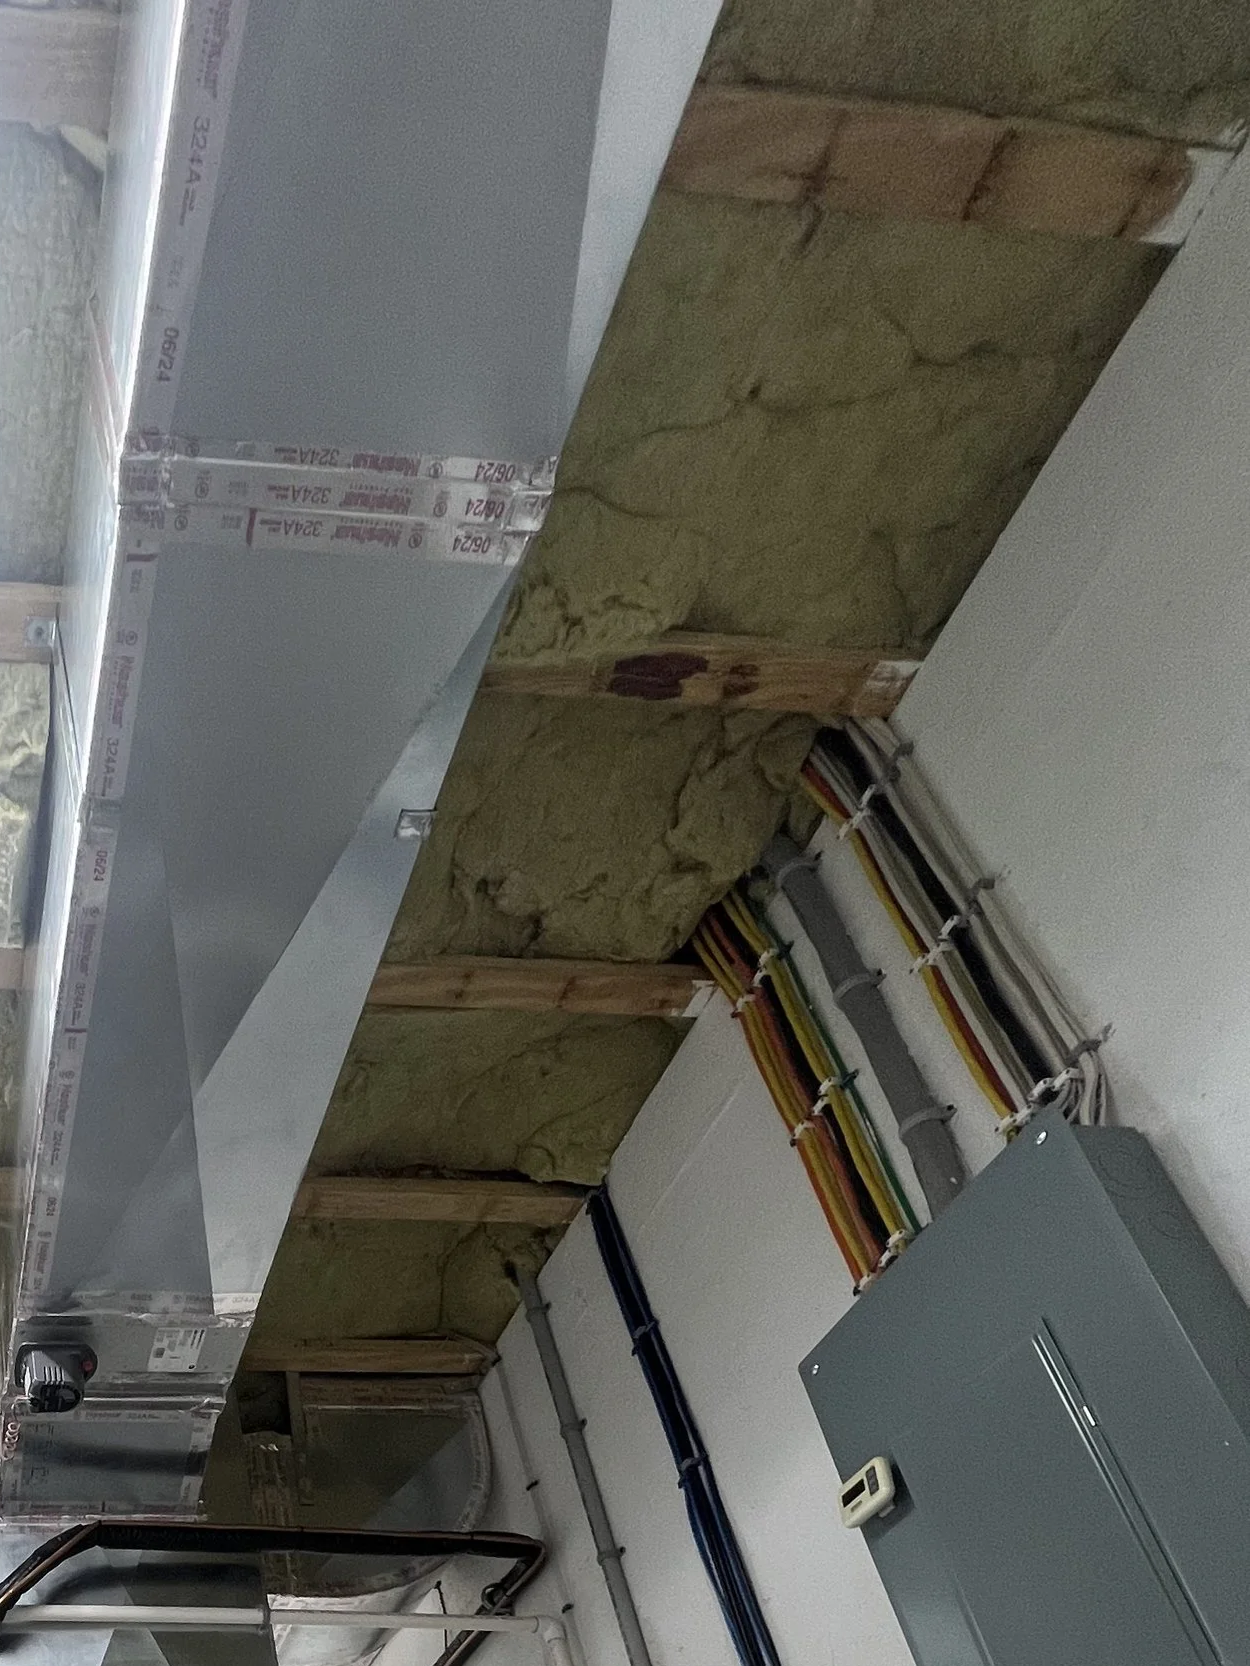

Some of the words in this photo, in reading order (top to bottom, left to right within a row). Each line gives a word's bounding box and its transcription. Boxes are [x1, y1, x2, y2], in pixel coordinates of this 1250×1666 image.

[157, 326, 180, 383] 06/24
[299, 449, 340, 467] 324A
[475, 461, 517, 483] 06/24
[291, 484, 332, 505] 324A
[465, 498, 506, 518] 06/24
[283, 519, 324, 538] 324A
[452, 534, 492, 554] 06/24
[106, 738, 120, 774] 324A
[93, 850, 108, 882] 06/24
